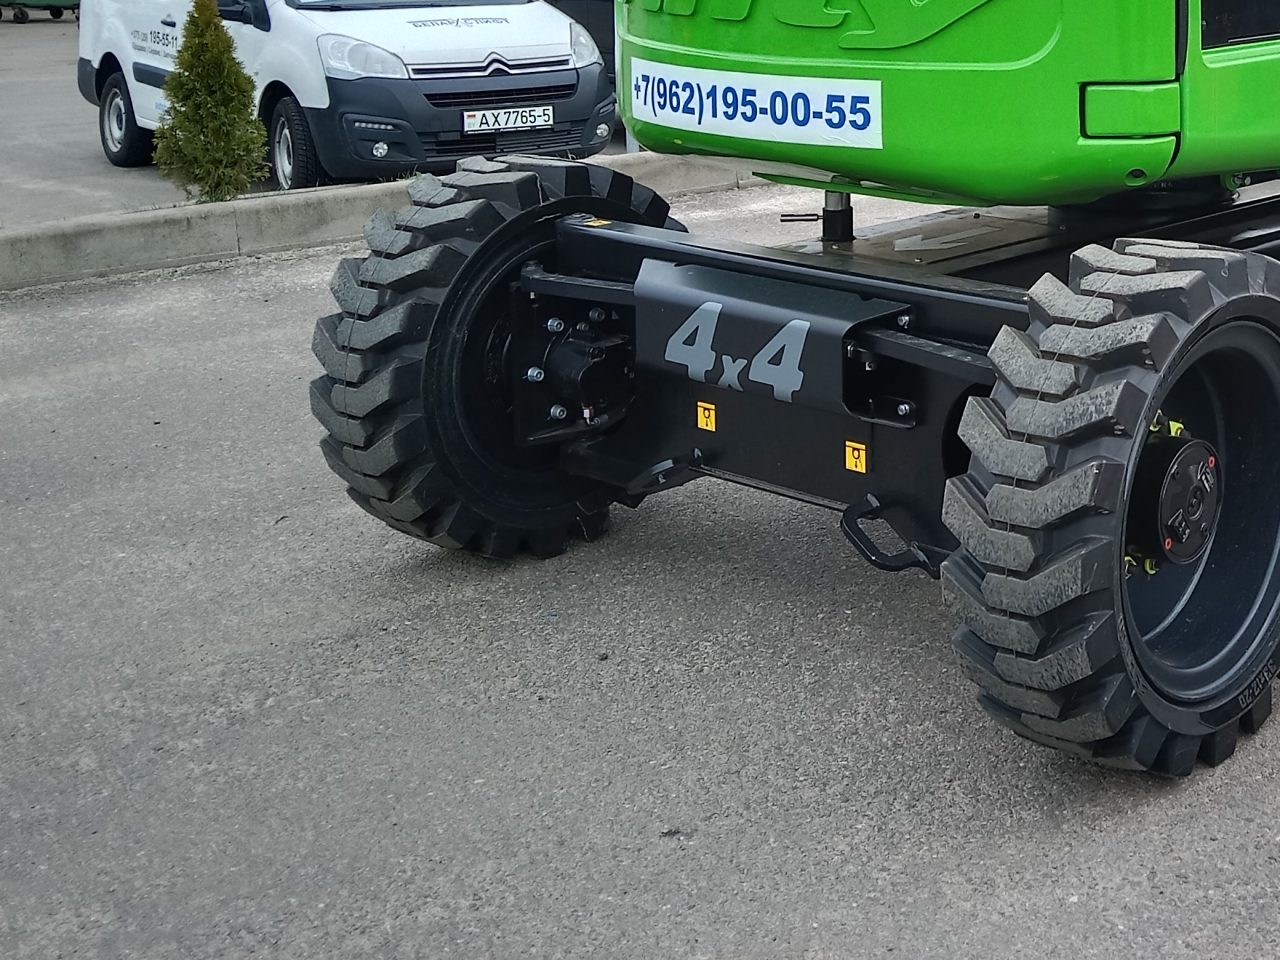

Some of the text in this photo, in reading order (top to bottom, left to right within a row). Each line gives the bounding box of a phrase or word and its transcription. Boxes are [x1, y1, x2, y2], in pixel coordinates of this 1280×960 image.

[149, 30, 178, 49] 195-55-11
[503, 108, 551, 126] 7765-5
[632, 74, 871, 131] +7(962)195-00-55
[664, 301, 811, 403] 4x4
